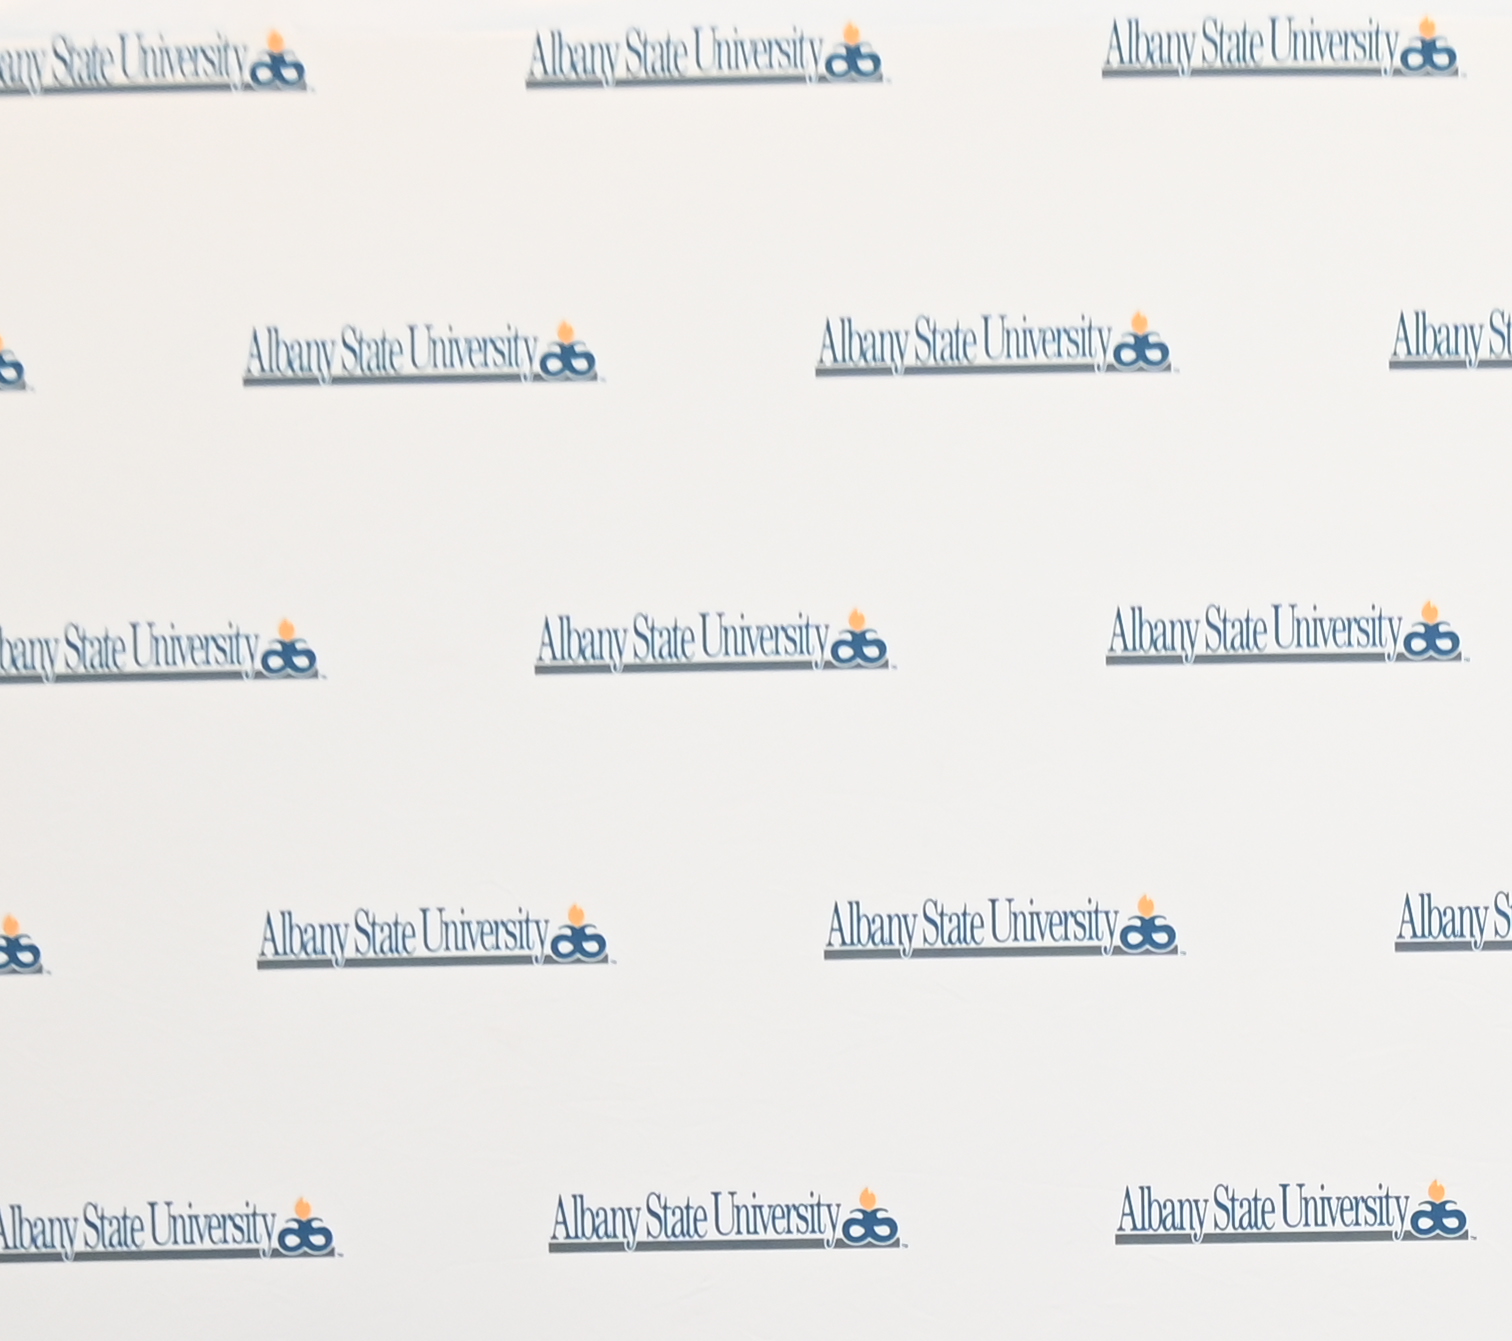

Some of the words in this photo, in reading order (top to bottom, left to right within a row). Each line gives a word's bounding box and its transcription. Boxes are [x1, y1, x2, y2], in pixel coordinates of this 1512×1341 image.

[51, 34, 114, 84] State
[117, 32, 249, 92] University
[528, 30, 621, 87] Albany
[625, 27, 688, 76] State
[692, 25, 824, 84] University
[1104, 17, 1197, 77] Albany
[1201, 16, 1264, 65] State
[1268, 16, 1400, 77] University
[245, 327, 337, 385] Albany
[340, 324, 404, 374] State
[407, 323, 539, 382] University
[818, 317, 910, 375] Albany
[914, 314, 977, 364] State
[981, 313, 1113, 373] University
[1391, 310, 1485, 368] Albany
[63, 622, 127, 672] State
[129, 620, 260, 680] University
[537, 615, 628, 673] Albany
[632, 612, 695, 661] State
[699, 611, 830, 670] University
[1108, 605, 1200, 664] Albany
[1204, 603, 1268, 652] State
[1271, 603, 1403, 662] University
[259, 910, 350, 968] Albany
[353, 907, 416, 956] State
[419, 906, 550, 964] University
[826, 900, 918, 958] Albany
[922, 897, 985, 947] State
[988, 897, 1119, 955] University
[1397, 892, 1489, 950] Albany
[82, 1201, 145, 1250] State
[147, 1199, 276, 1258] University
[551, 1193, 641, 1251] Albany
[645, 1191, 708, 1240] State
[711, 1190, 841, 1248] University
[1117, 1185, 1209, 1243] Albany
[1213, 1183, 1276, 1232] State
[1279, 1182, 1410, 1240] University
